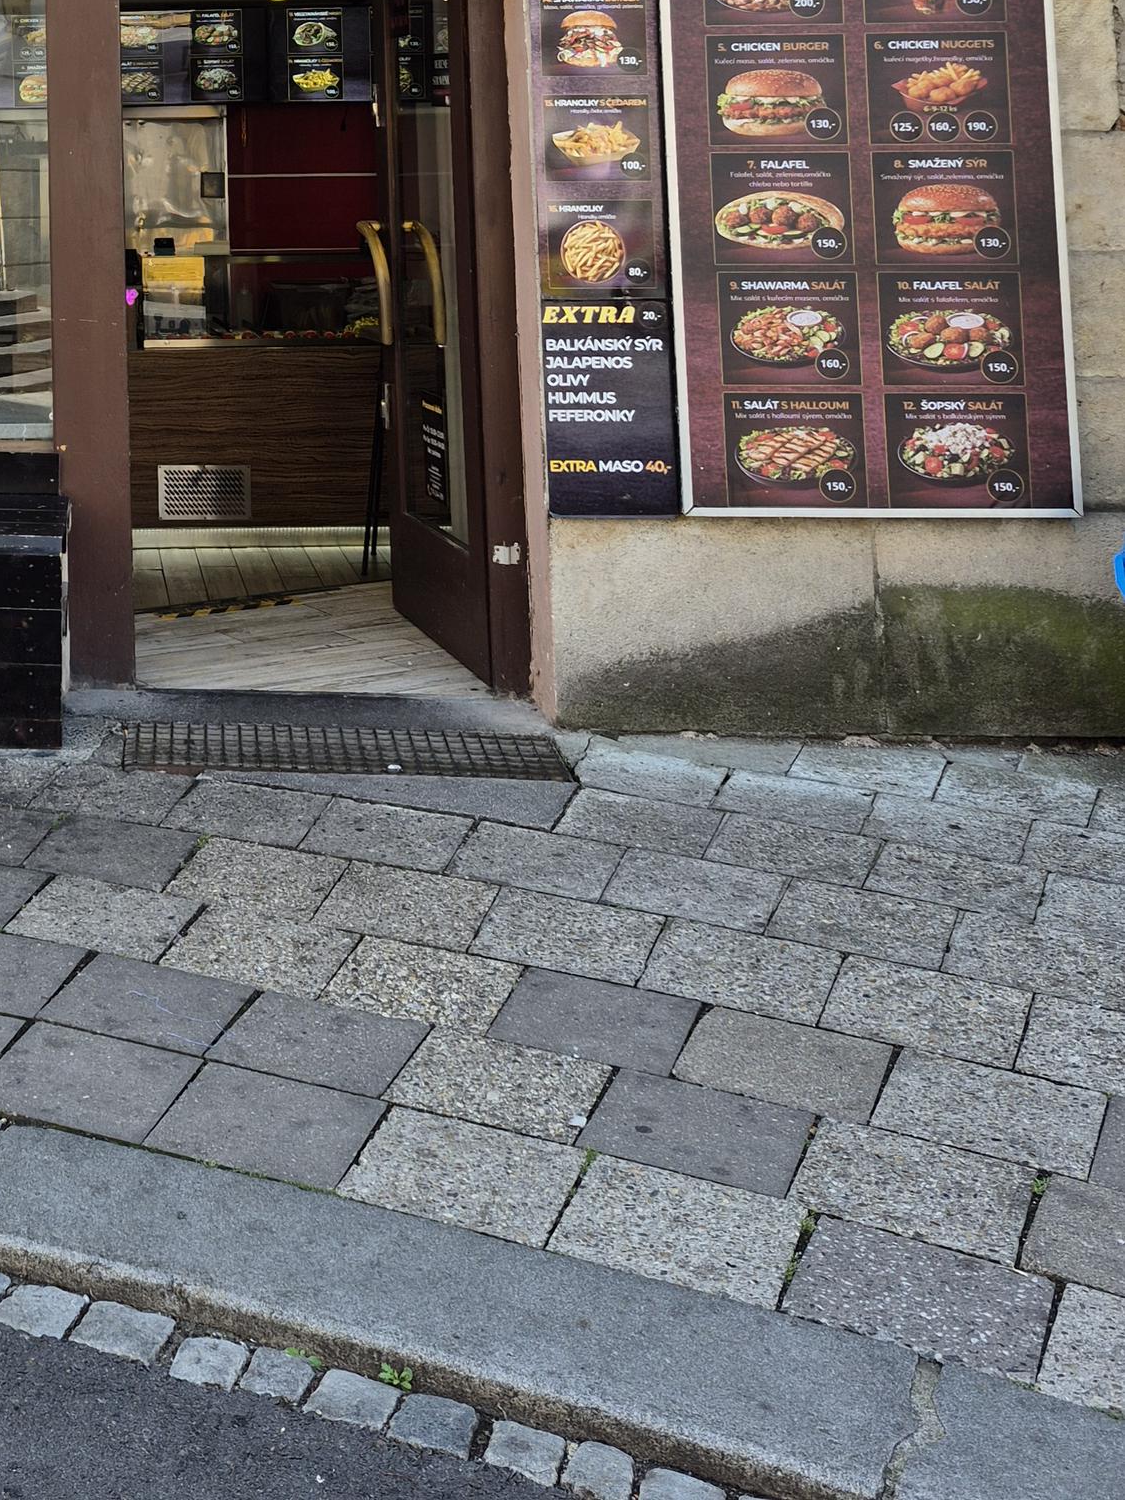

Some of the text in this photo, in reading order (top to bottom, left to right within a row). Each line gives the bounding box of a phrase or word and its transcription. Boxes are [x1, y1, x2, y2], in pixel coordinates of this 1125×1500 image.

[731, 42, 780, 51] CHICKEN
[782, 41, 829, 51] BURGER
[888, 40, 939, 49] CHICKEN
[940, 39, 994, 49] NUGGETS
[619, 56, 642, 66] 130,-
[809, 119, 836, 130] 130,-
[893, 121, 993, 133] 125,- 160,- 190,-
[747, 160, 809, 169] 7. FALAFEL
[908, 157, 964, 168] SMAŽENÝ
[965, 157, 987, 168] SÝR
[816, 238, 842, 250] 150,-
[980, 238, 1006, 249] 130,-
[629, 268, 648, 277] 80,-
[741, 281, 809, 290] SHAWARMA
[811, 279, 846, 290] SALÁT
[913, 281, 963, 290] FALAFEL
[964, 279, 1001, 290] SALÁT
[542, 305, 661, 324] EXTRA 20,-
[546, 336, 663, 351] BALKÁNSKÝ SÝR
[546, 356, 633, 369] JALAPENOS
[820, 359, 846, 370] 160,-
[987, 363, 1014, 373] 150,-
[547, 374, 590, 387] OLIVY
[548, 392, 617, 404] HUMMUS
[743, 398, 779, 410] SALÁT
[780, 401, 788, 410] S
[790, 401, 849, 410] HALLOUMI
[920, 398, 966, 411] ŠOPSKÝ
[967, 399, 1003, 410] SALÁT
[549, 409, 635, 422] FEFERONKY
[550, 460, 672, 475] EXTRA MASO 40,-
[826, 481, 852, 492] 150,-
[993, 482, 1020, 493] 150,-
